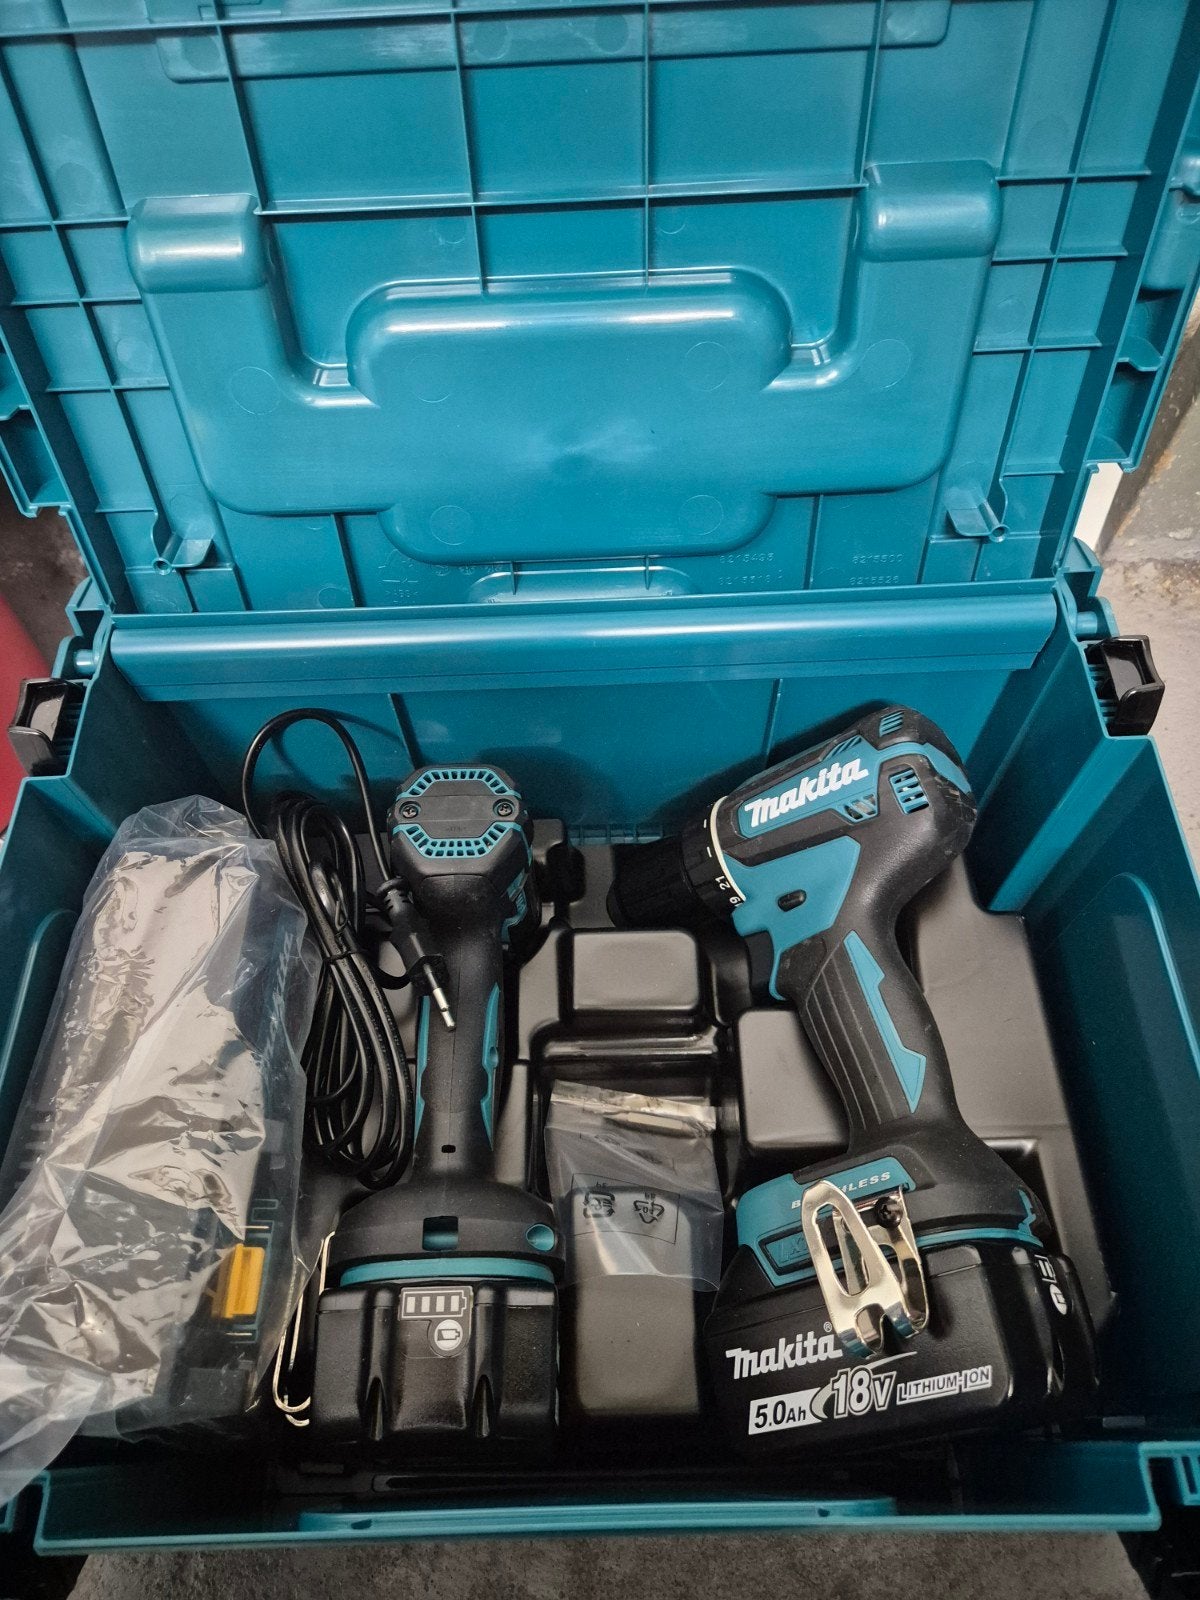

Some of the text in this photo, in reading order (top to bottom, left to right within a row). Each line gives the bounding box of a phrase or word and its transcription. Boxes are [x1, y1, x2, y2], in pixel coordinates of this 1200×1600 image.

[744, 758, 869, 827] Makita
[715, 875, 731, 891] 21
[725, 1330, 843, 1380] Makita
[753, 1366, 992, 1429] 5.0Ah 18V LITHIUM-ION
